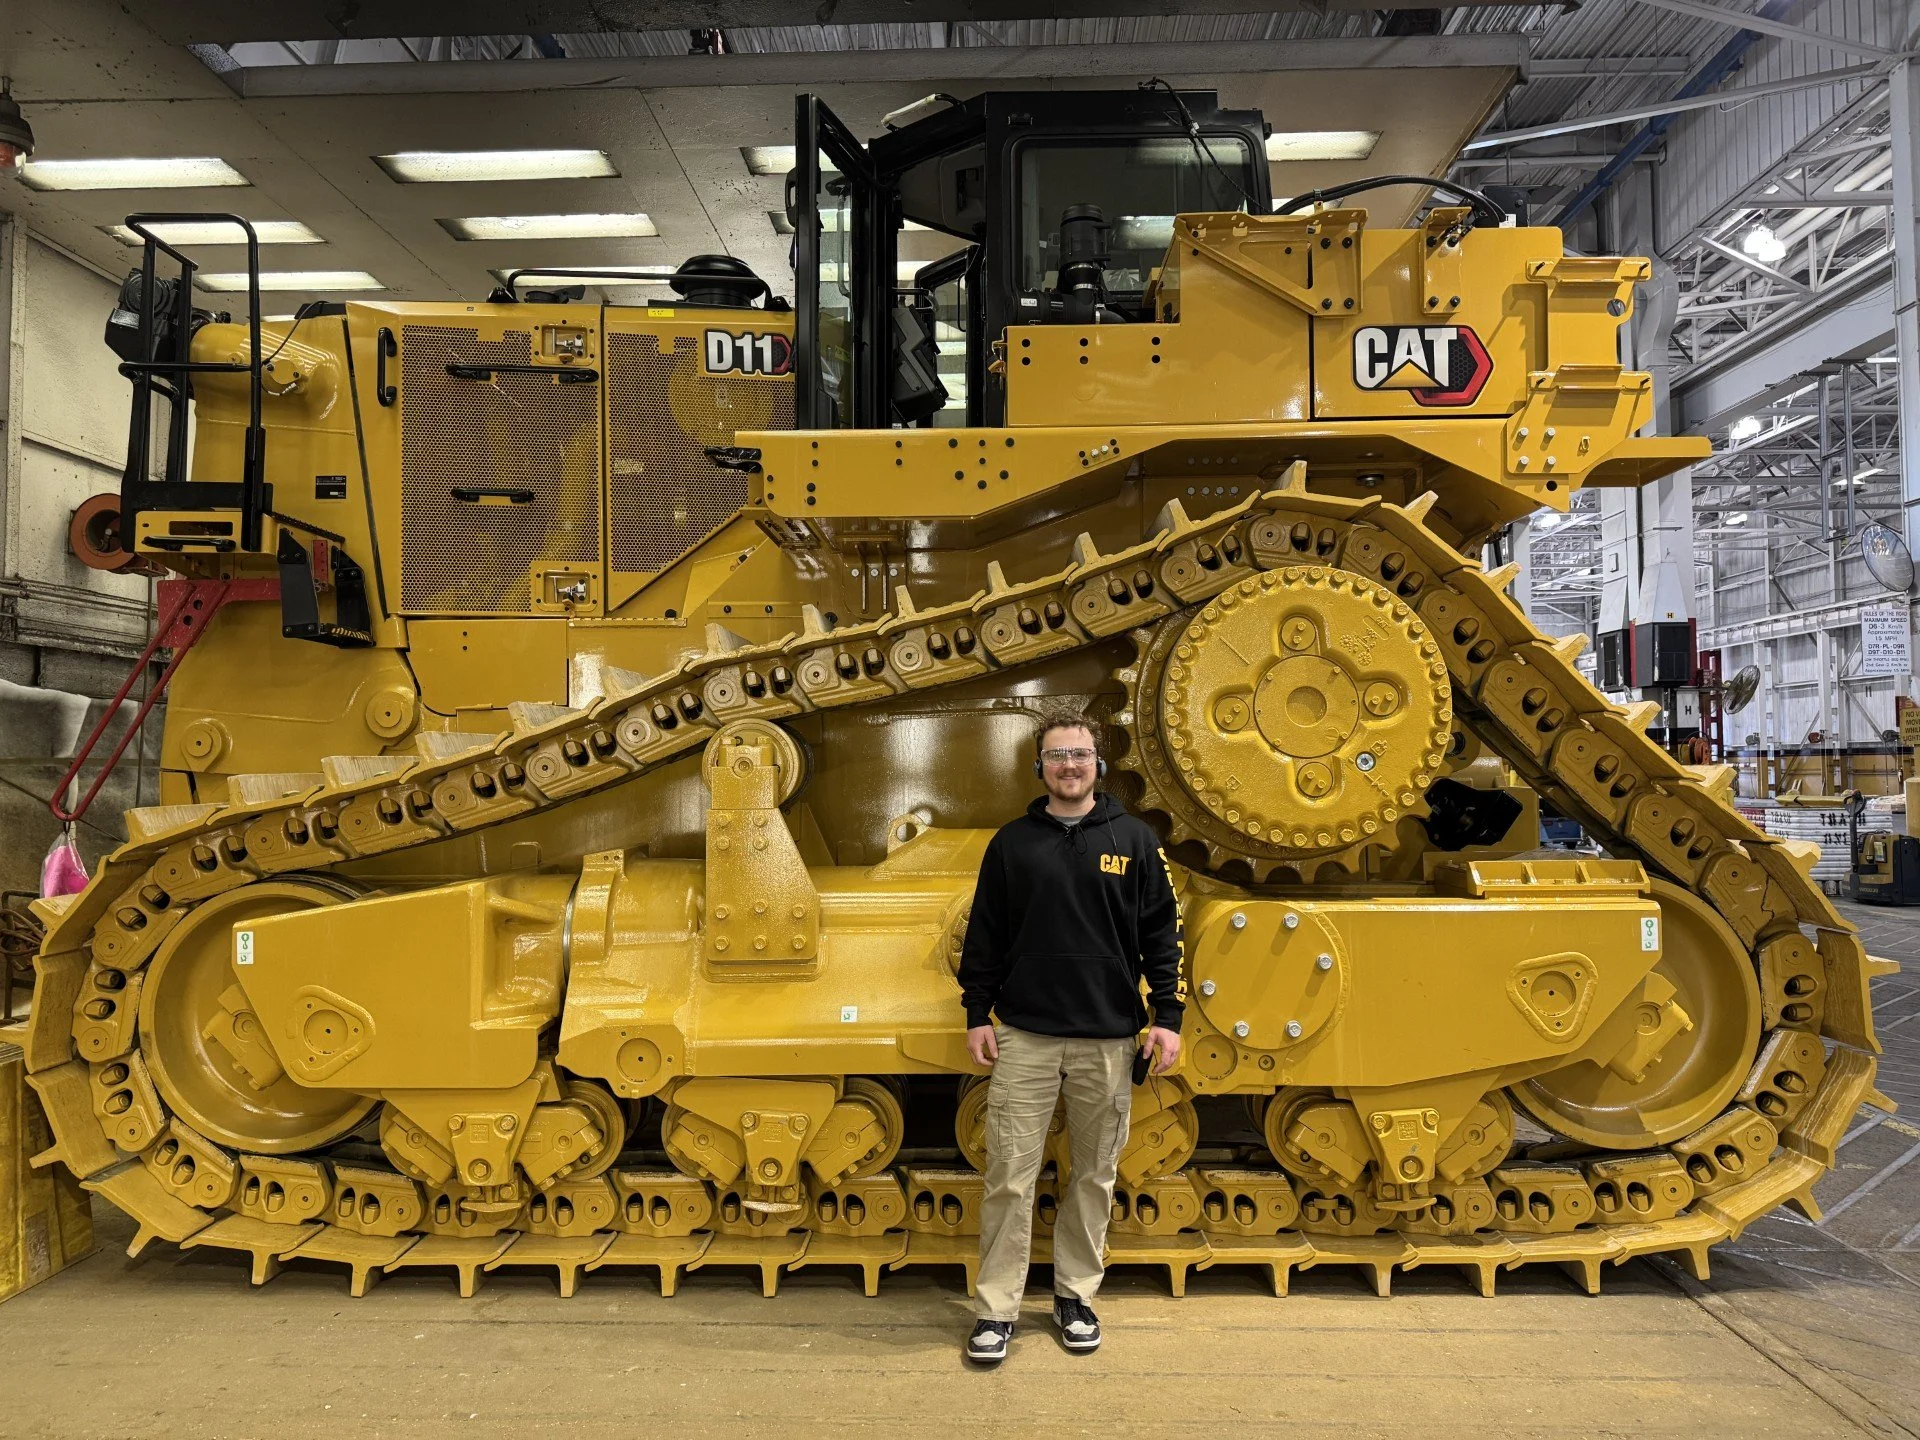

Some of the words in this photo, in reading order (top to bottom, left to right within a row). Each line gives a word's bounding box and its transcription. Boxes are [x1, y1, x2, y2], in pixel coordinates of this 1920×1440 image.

[707, 331, 772, 373] D11
[1355, 327, 1458, 388] CAT
[1685, 705, 1692, 715] H
[1100, 854, 1130, 876] CAT
